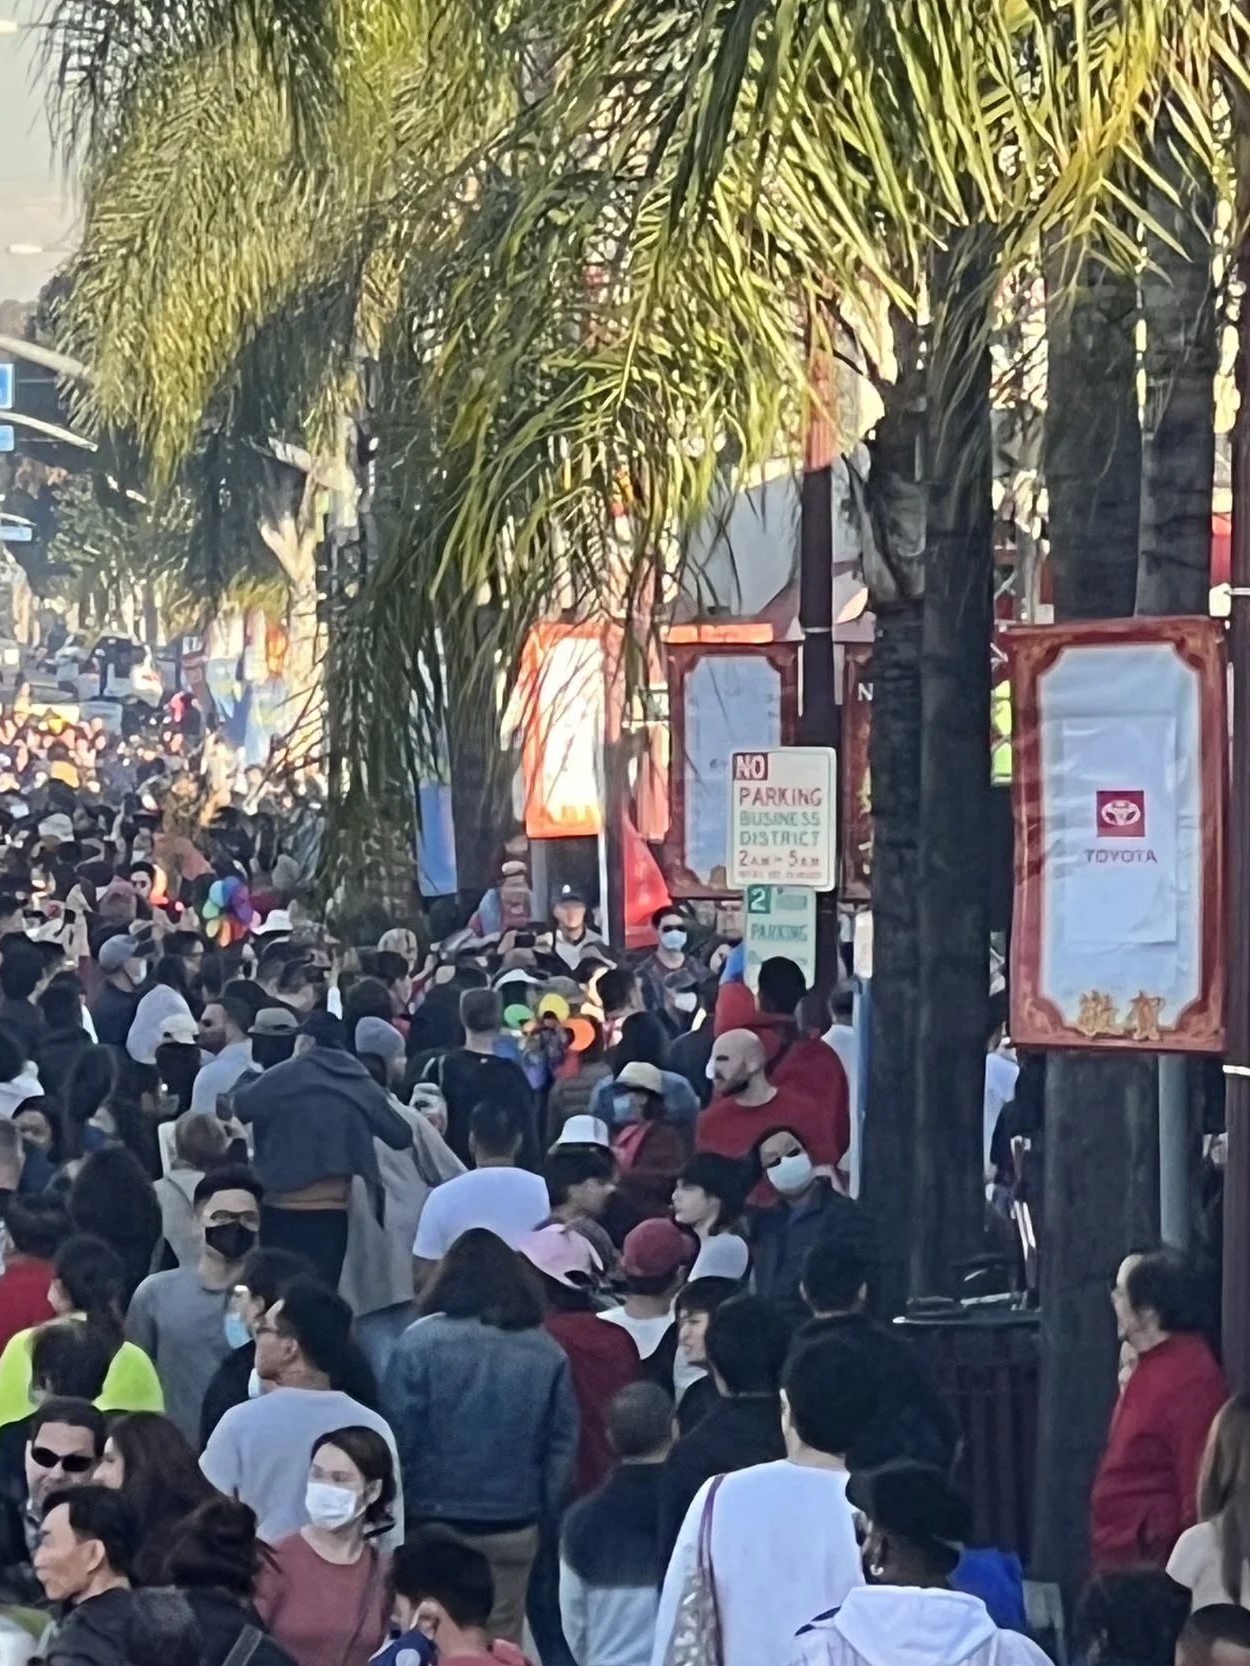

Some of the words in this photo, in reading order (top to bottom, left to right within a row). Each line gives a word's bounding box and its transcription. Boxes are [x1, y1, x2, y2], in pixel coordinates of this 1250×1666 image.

[736, 754, 765, 779] NO
[739, 787, 822, 807] PARKING
[739, 810, 821, 827] BUSINESS
[739, 831, 820, 847] DISTRICT
[1084, 849, 1158, 864] TOYOTA
[751, 888, 767, 911] 2
[751, 923, 808, 941] PARKING
